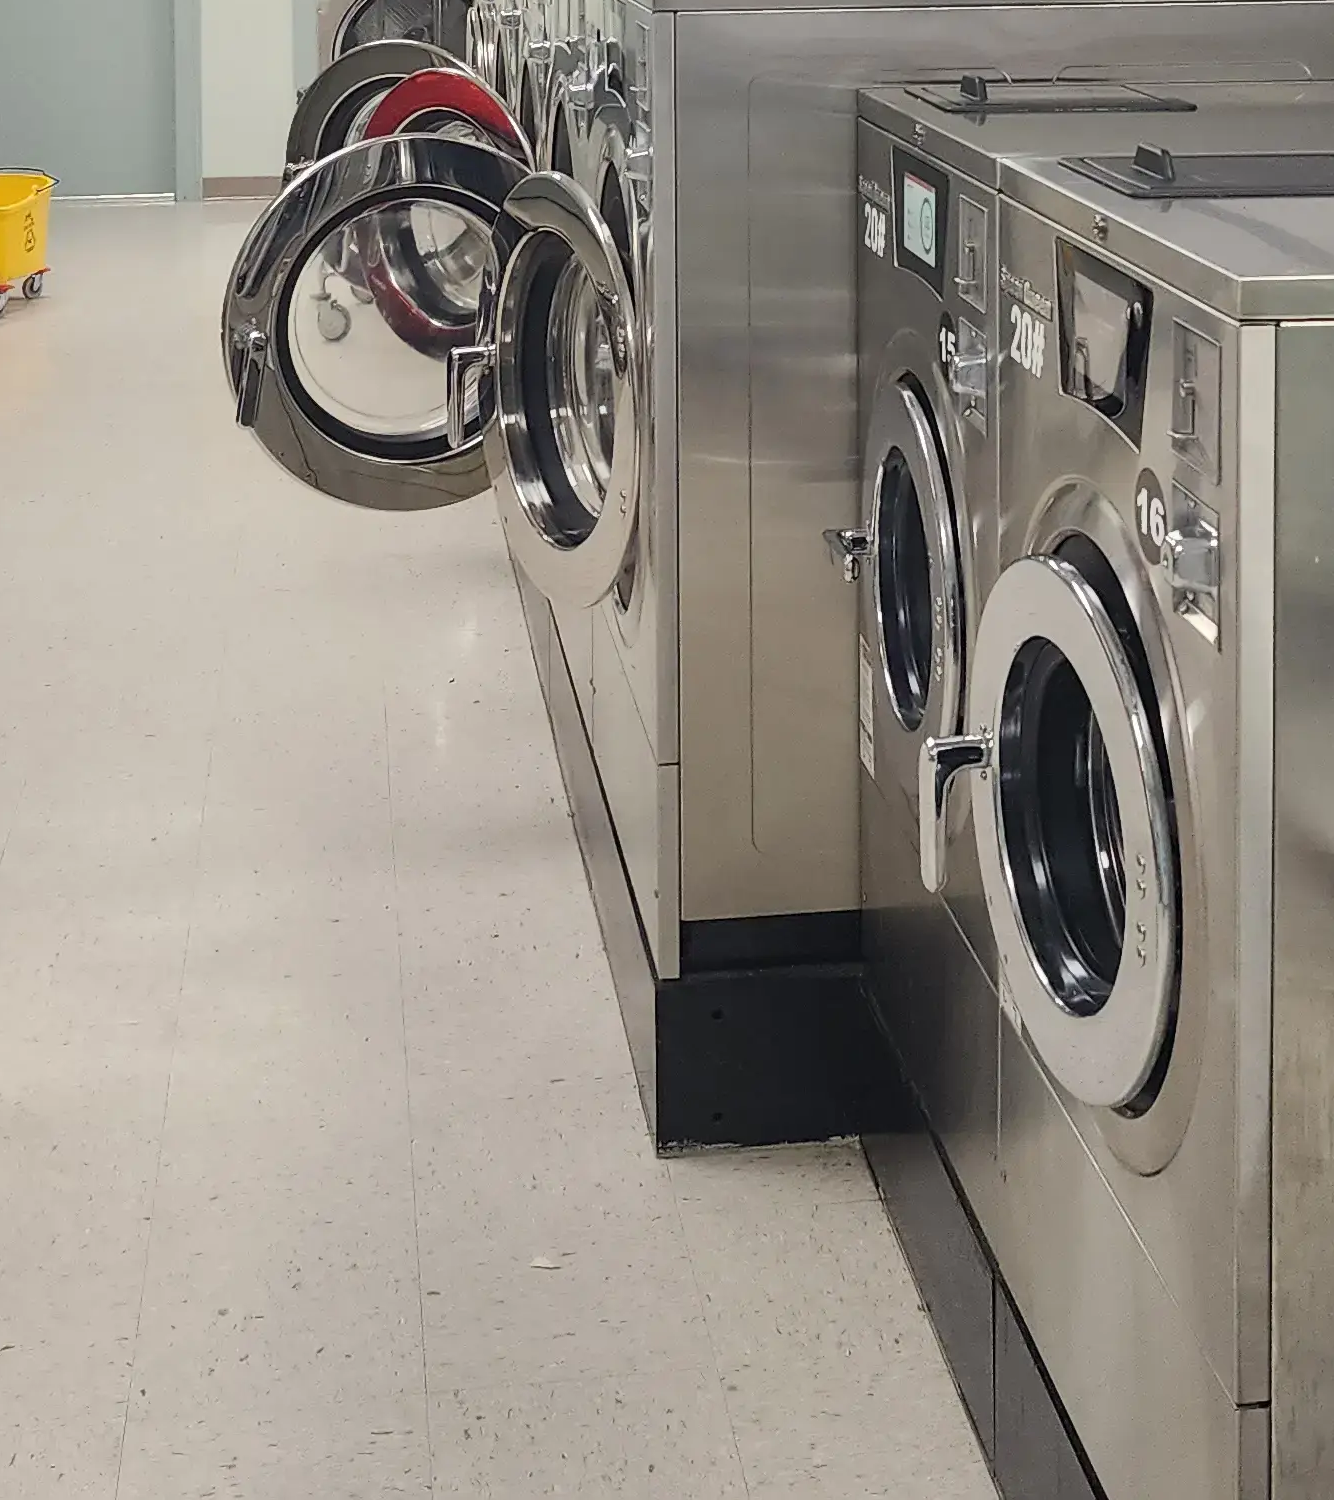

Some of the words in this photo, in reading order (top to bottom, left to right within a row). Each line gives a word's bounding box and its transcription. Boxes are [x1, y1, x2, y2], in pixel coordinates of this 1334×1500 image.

[864, 202, 886, 258] 20#
[939, 327, 957, 363] 15
[1010, 304, 1046, 379] 20#
[1136, 487, 1165, 547] 16
